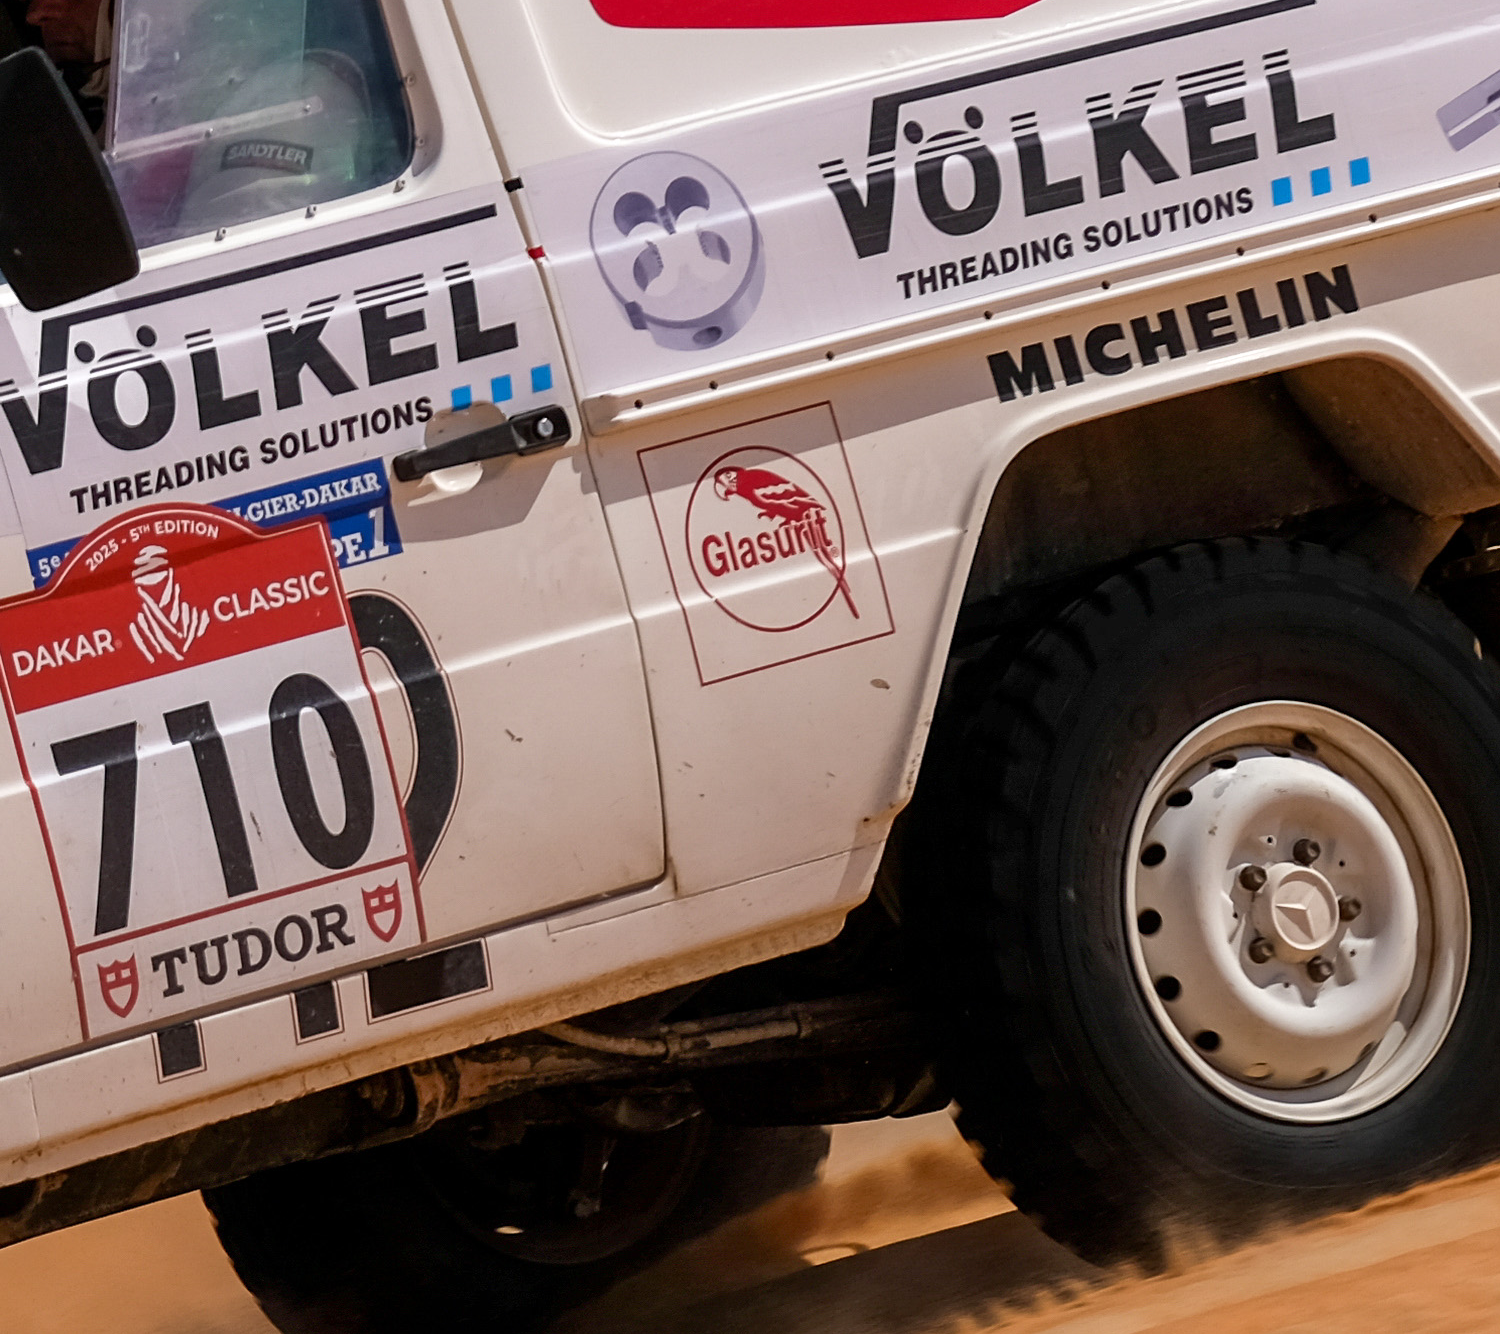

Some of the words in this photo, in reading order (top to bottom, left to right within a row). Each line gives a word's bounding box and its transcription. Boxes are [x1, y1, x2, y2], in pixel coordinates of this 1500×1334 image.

[897, 227, 1073, 300] THREADING
[1083, 185, 1253, 253] SOLUTIONS
[987, 265, 1359, 402] MICHELIN
[70, 449, 250, 515] THREADING
[259, 396, 434, 466] SOLUTIONS
[85, 538, 120, 572] 2025
[155, 519, 219, 540] EDITION
[12, 628, 116, 677] DAKAR
[213, 570, 330, 623] CLASSIC
[50, 672, 376, 937] 710
[152, 903, 355, 999] TUDOR
